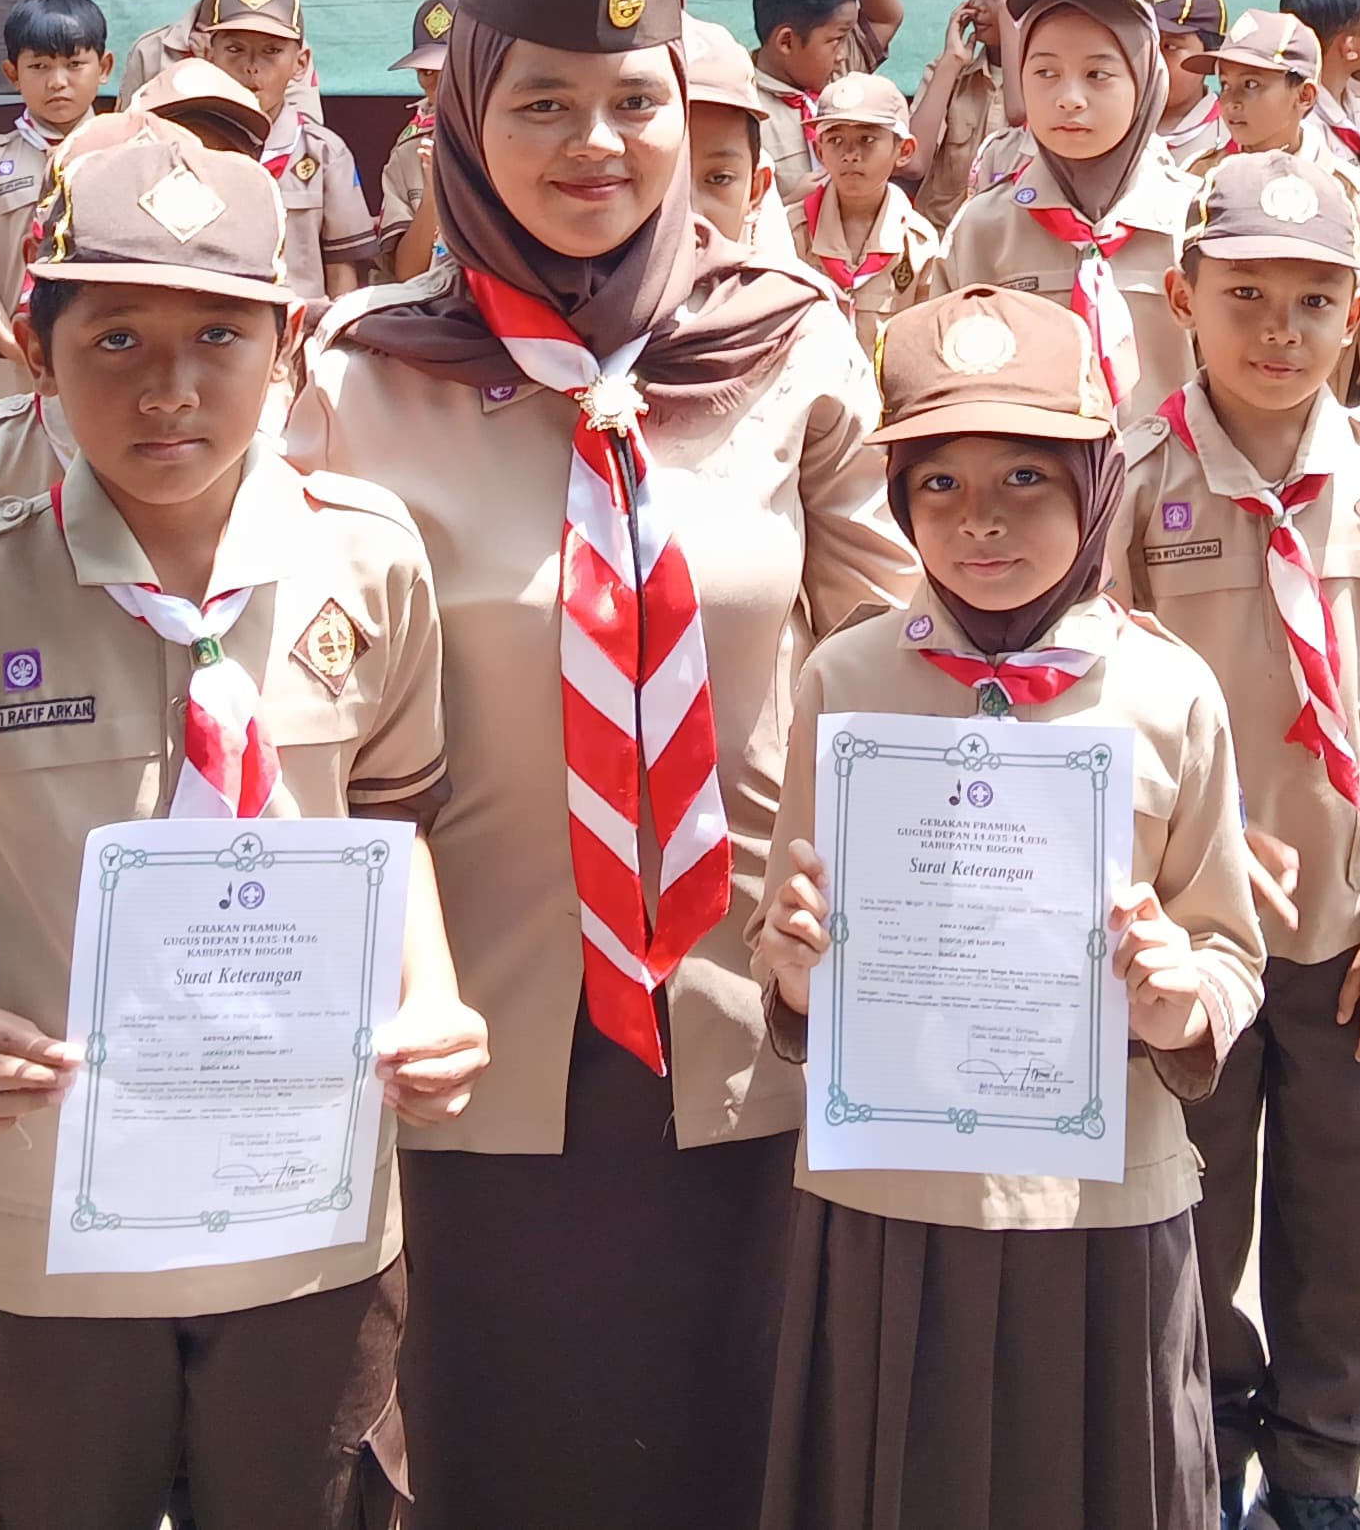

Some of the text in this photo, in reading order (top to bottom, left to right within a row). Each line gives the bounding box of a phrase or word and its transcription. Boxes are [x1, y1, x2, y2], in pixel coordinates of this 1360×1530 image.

[8, 706, 44, 724] RAFIF
[47, 701, 91, 720] ARKAN
[909, 857, 1034, 883] Surat Keterangan
[174, 968, 303, 986] Surat Keterangan
